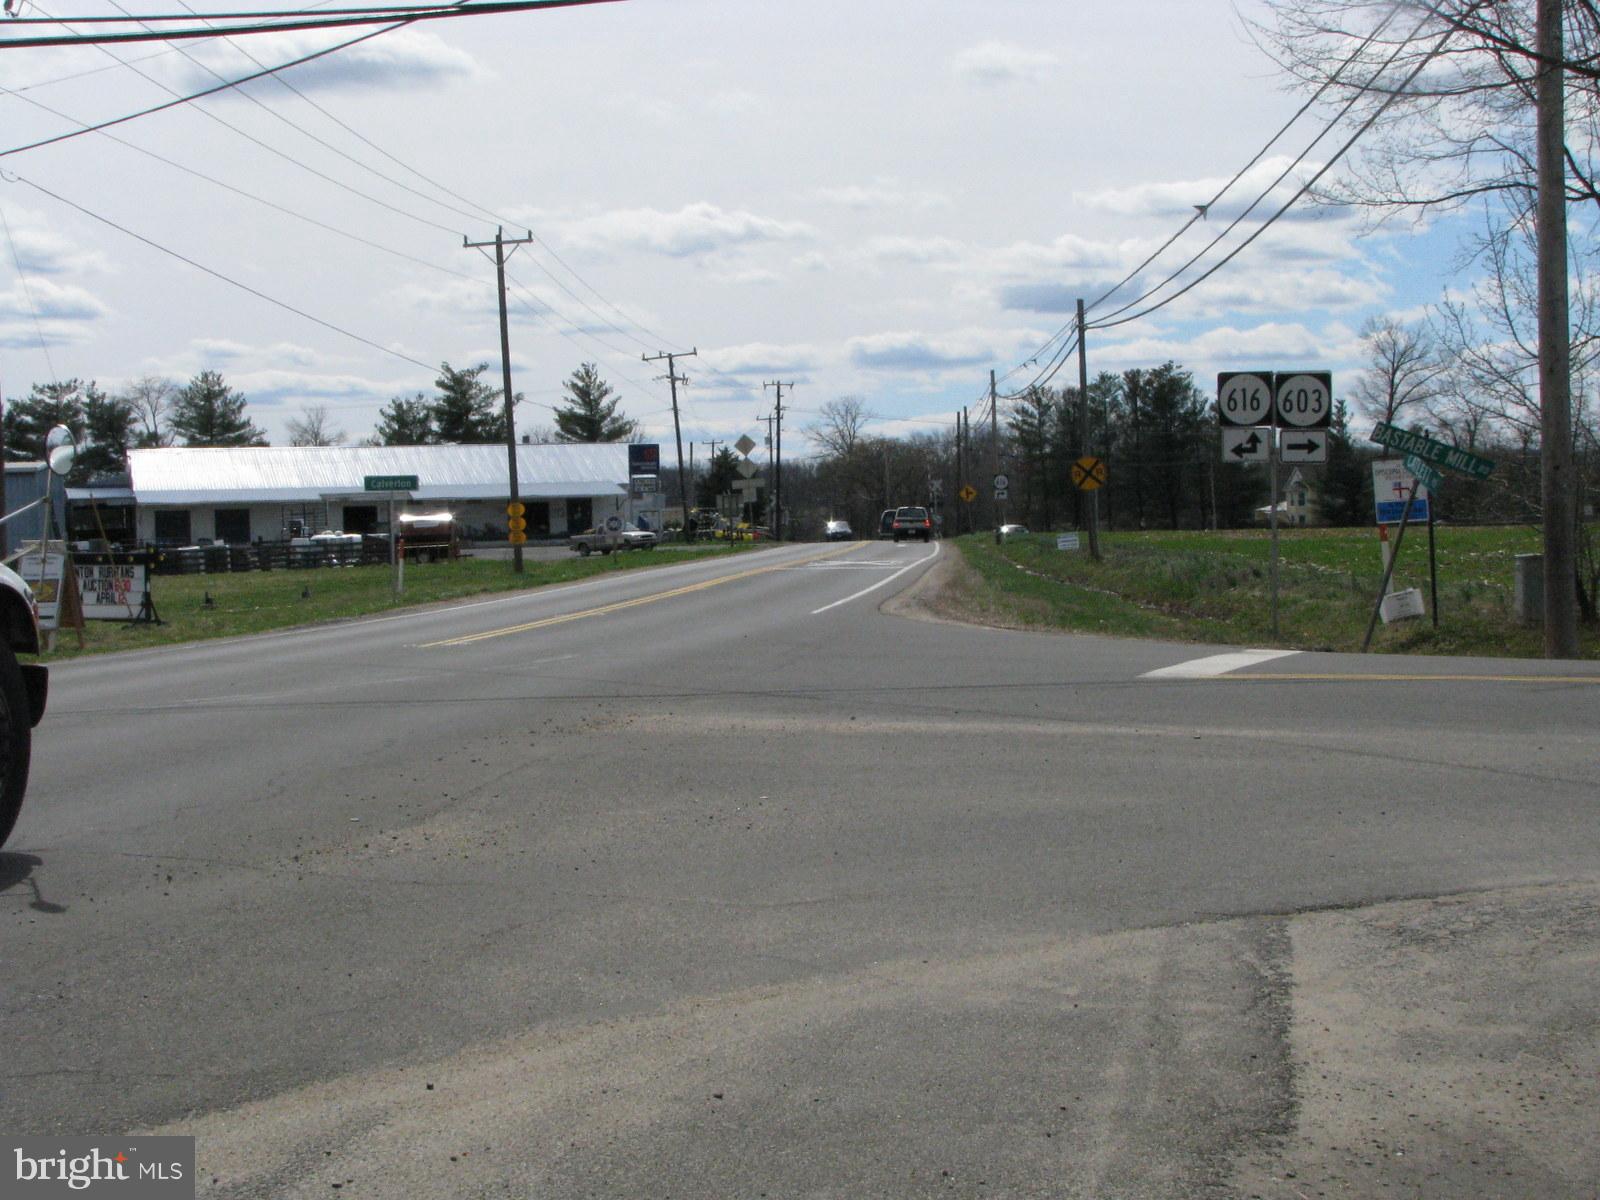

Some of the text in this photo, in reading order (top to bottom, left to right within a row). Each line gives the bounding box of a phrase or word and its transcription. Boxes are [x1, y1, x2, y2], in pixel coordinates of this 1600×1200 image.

[1227, 388, 1261, 412] 616
[1282, 388, 1323, 414] 603
[1374, 426, 1444, 460] BASTABLE
[1444, 450, 1477, 475] MILL
[83, 580, 114, 592] AUCTION
[96, 592, 116, 606] APRIL
